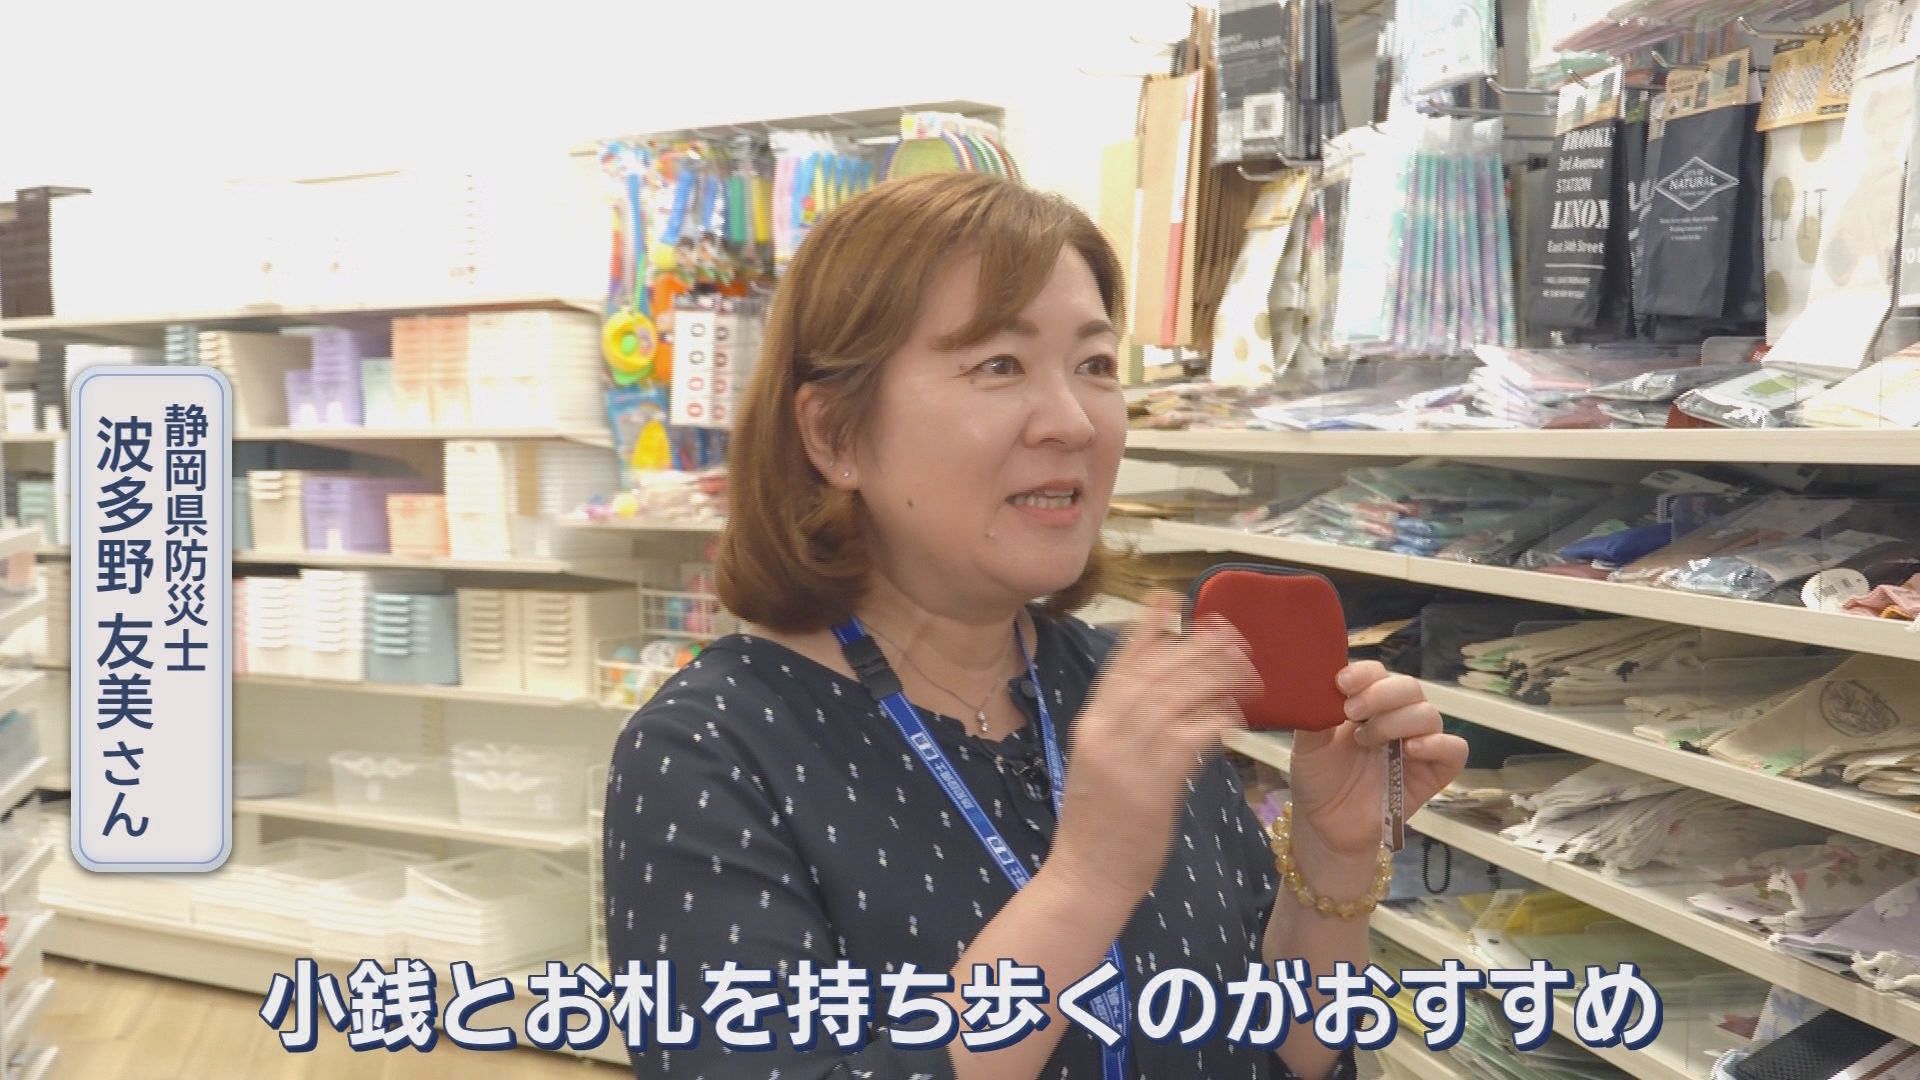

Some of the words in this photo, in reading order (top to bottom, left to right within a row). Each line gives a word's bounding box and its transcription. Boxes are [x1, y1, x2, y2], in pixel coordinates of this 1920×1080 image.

[1561, 127, 1617, 152] BROOKL
[1573, 156, 1606, 171] Avenue
[1555, 177, 1593, 194] STATION
[1669, 175, 1718, 191] NATURAL
[1577, 240, 1605, 255] Street
